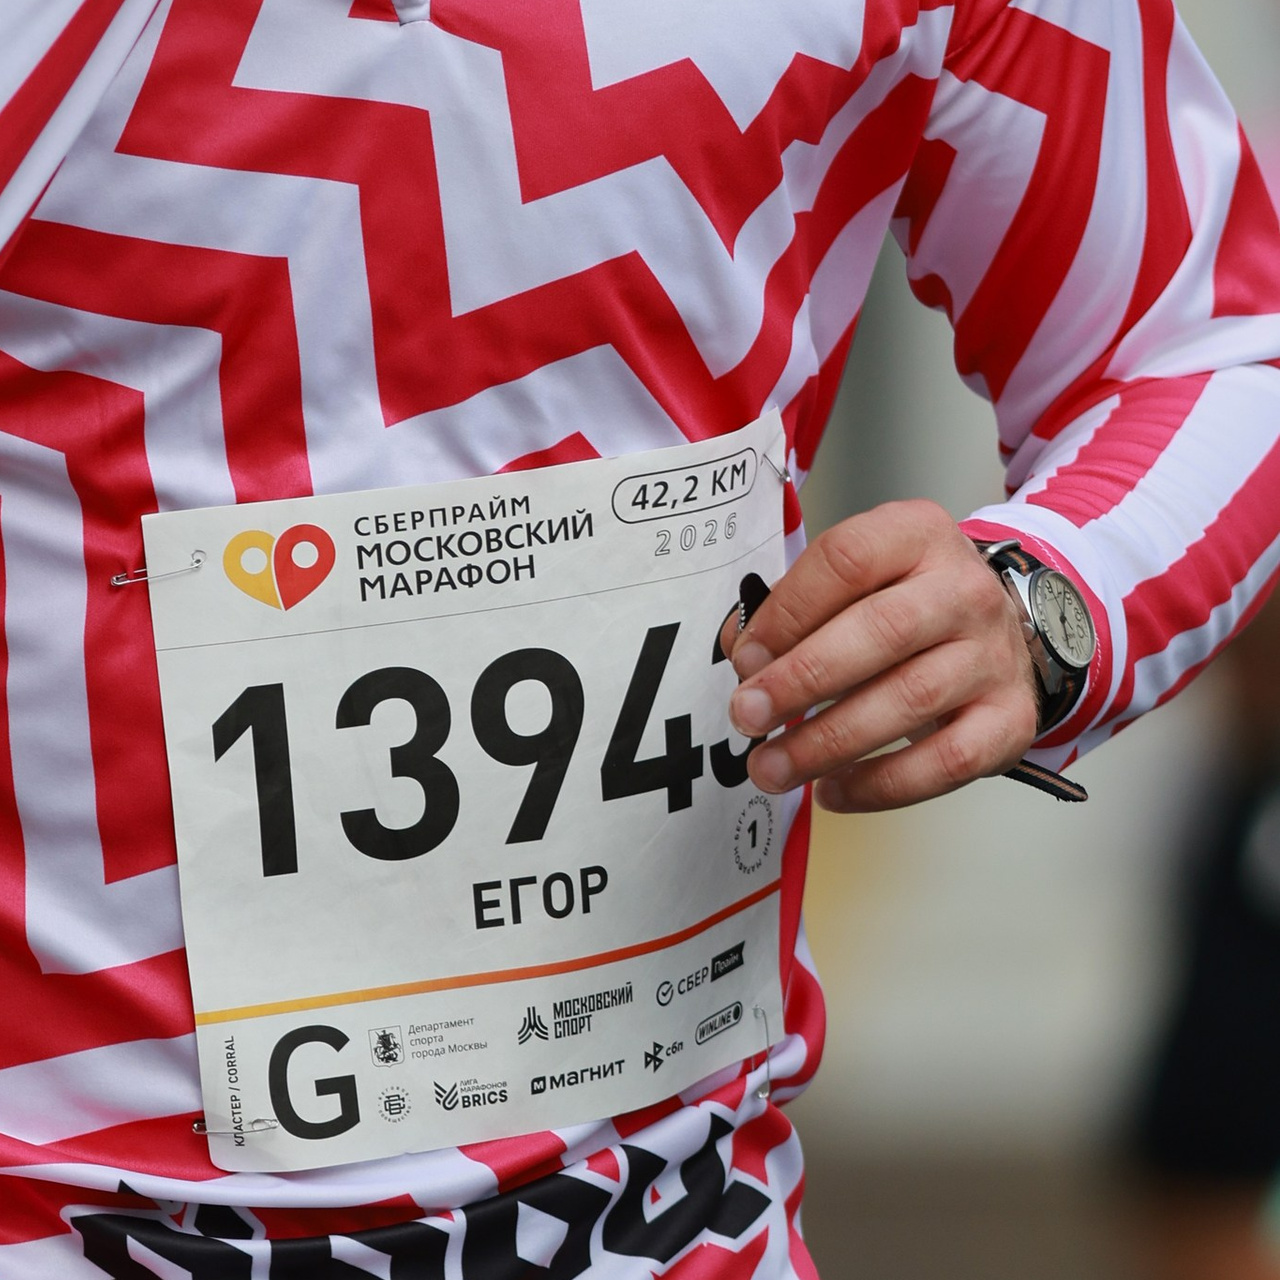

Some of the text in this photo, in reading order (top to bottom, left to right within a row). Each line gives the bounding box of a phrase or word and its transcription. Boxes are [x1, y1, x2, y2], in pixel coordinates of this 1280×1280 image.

[631, 475, 699, 511] 42,2
[353, 495, 531, 537] СБЕРПРАЙМ
[356, 508, 595, 570] МОСКОВСКИЙ
[654, 512, 737, 557] 2026
[359, 554, 537, 602] МАРАФОН
[747, 819, 757, 849] 1
[472, 863, 610, 930] ЕГОР
[677, 966, 709, 995] СБЕР
[553, 981, 634, 1020] МОСКОВСКИЙ
[408, 1018, 475, 1035] Департамент
[554, 1014, 593, 1039] СПОРТ
[698, 1009, 732, 1040] WINLINE
[409, 1034, 444, 1047] спорта
[411, 1041, 488, 1060] города Москвы
[665, 1040, 684, 1057] сбп
[224, 1035, 239, 1084] CORRAL
[268, 1024, 361, 1141] G
[459, 1078, 479, 1087] ЛИГА
[460, 1081, 508, 1093] МАРАФОНОВ
[461, 1089, 509, 1109] BRICS
[230, 1094, 246, 1147] КЛАСТЕР
